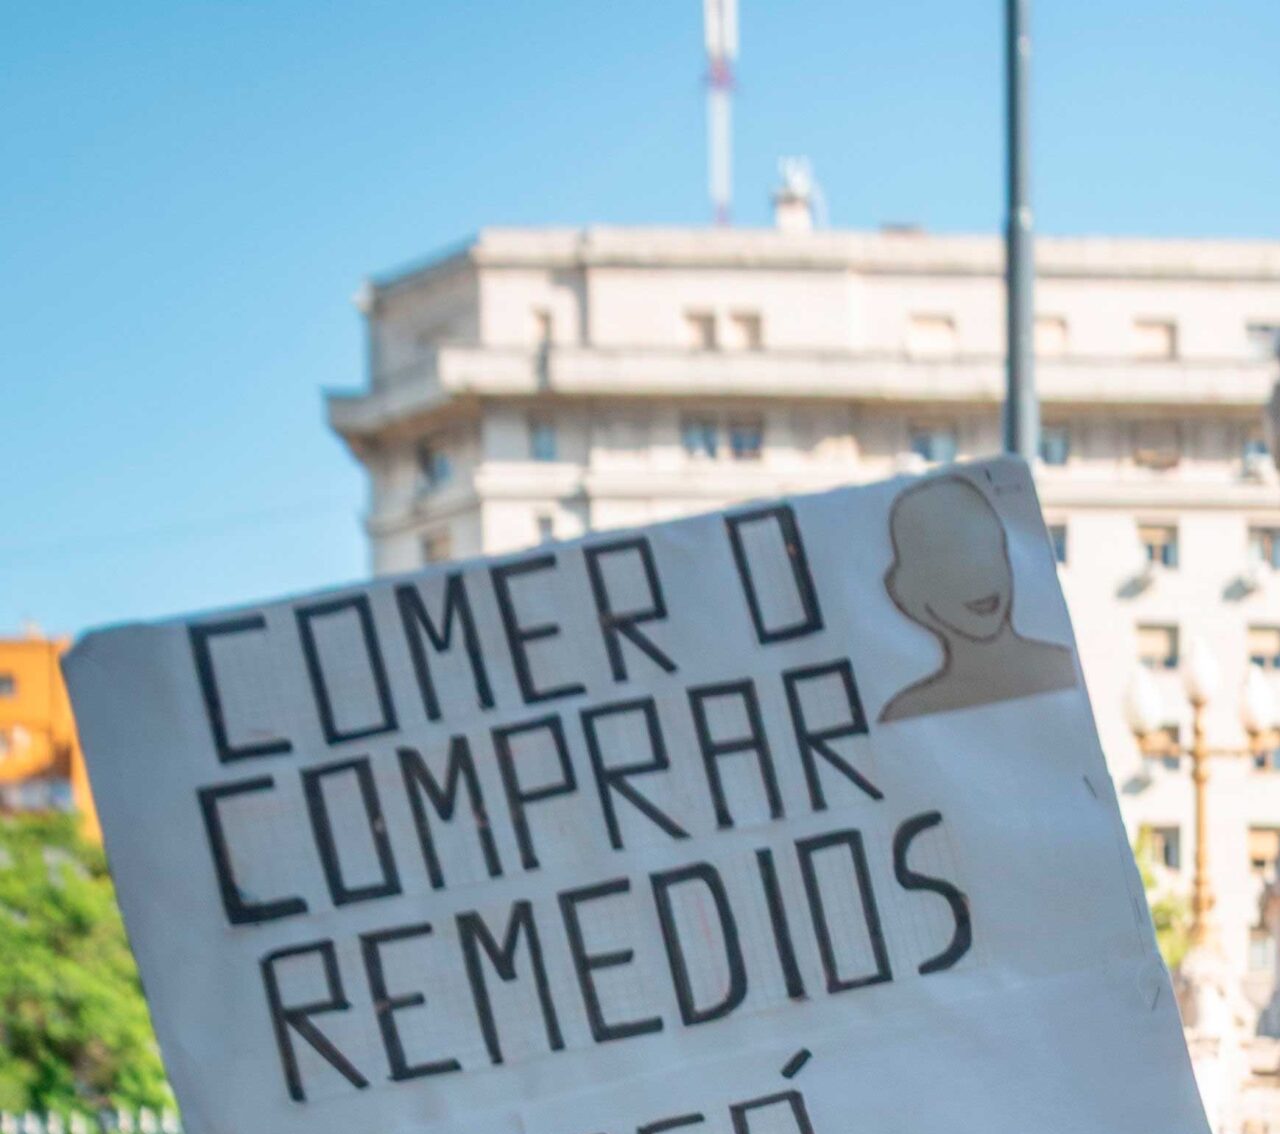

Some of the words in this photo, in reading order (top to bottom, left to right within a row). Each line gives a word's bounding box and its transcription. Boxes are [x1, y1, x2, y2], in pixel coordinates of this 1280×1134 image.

[187, 537, 678, 763] COMER
[724, 504, 825, 645] O
[197, 658, 885, 926] COMPRAR
[260, 810, 973, 1103] REMEDIOS
